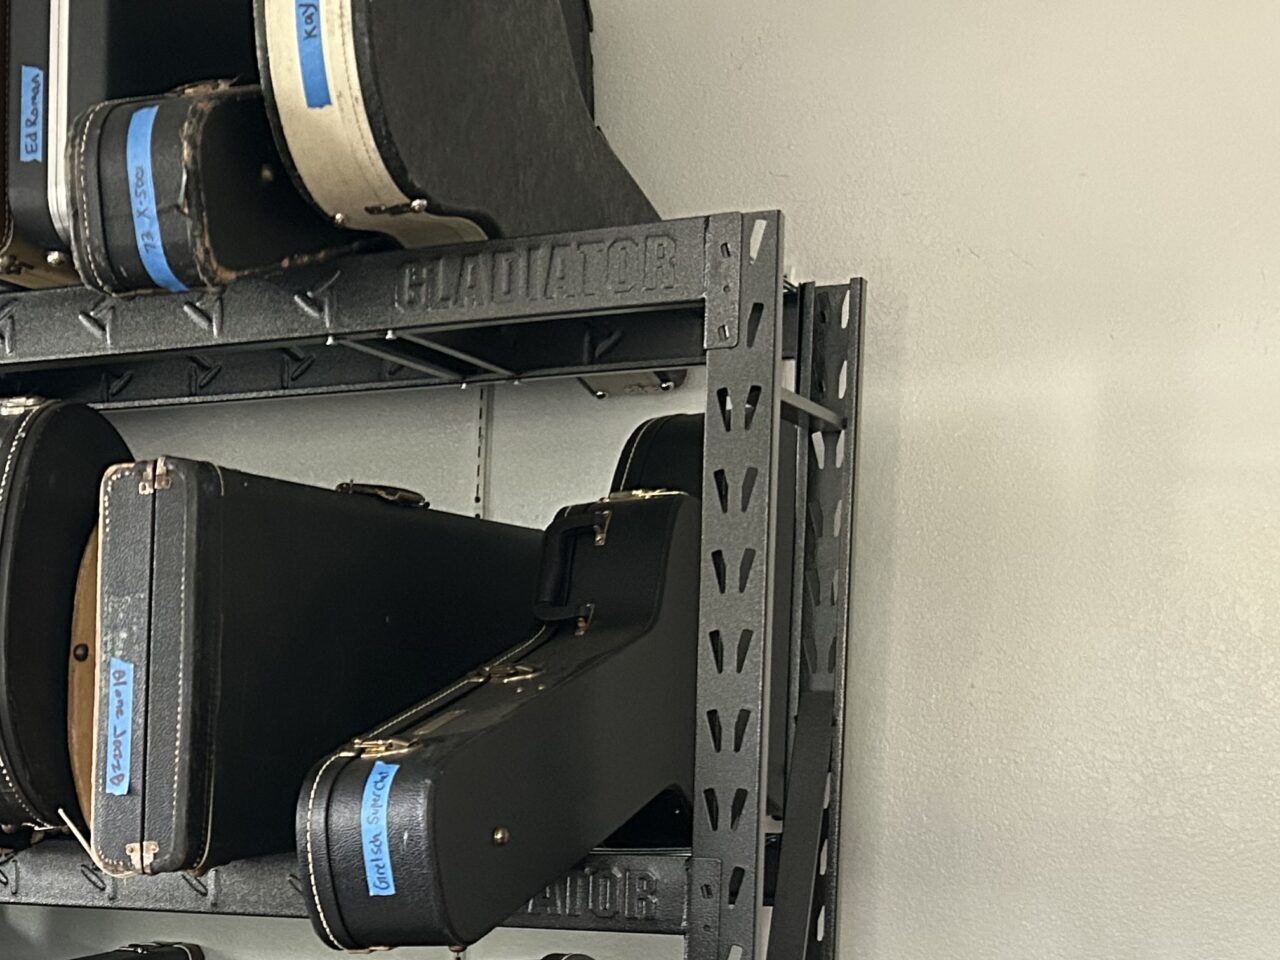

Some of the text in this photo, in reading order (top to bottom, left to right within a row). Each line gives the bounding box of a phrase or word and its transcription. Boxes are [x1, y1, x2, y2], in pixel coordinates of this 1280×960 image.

[297, 2, 319, 41] Kay
[23, 73, 41, 156] Ed Roman
[392, 234, 678, 312] GLADIATOR
